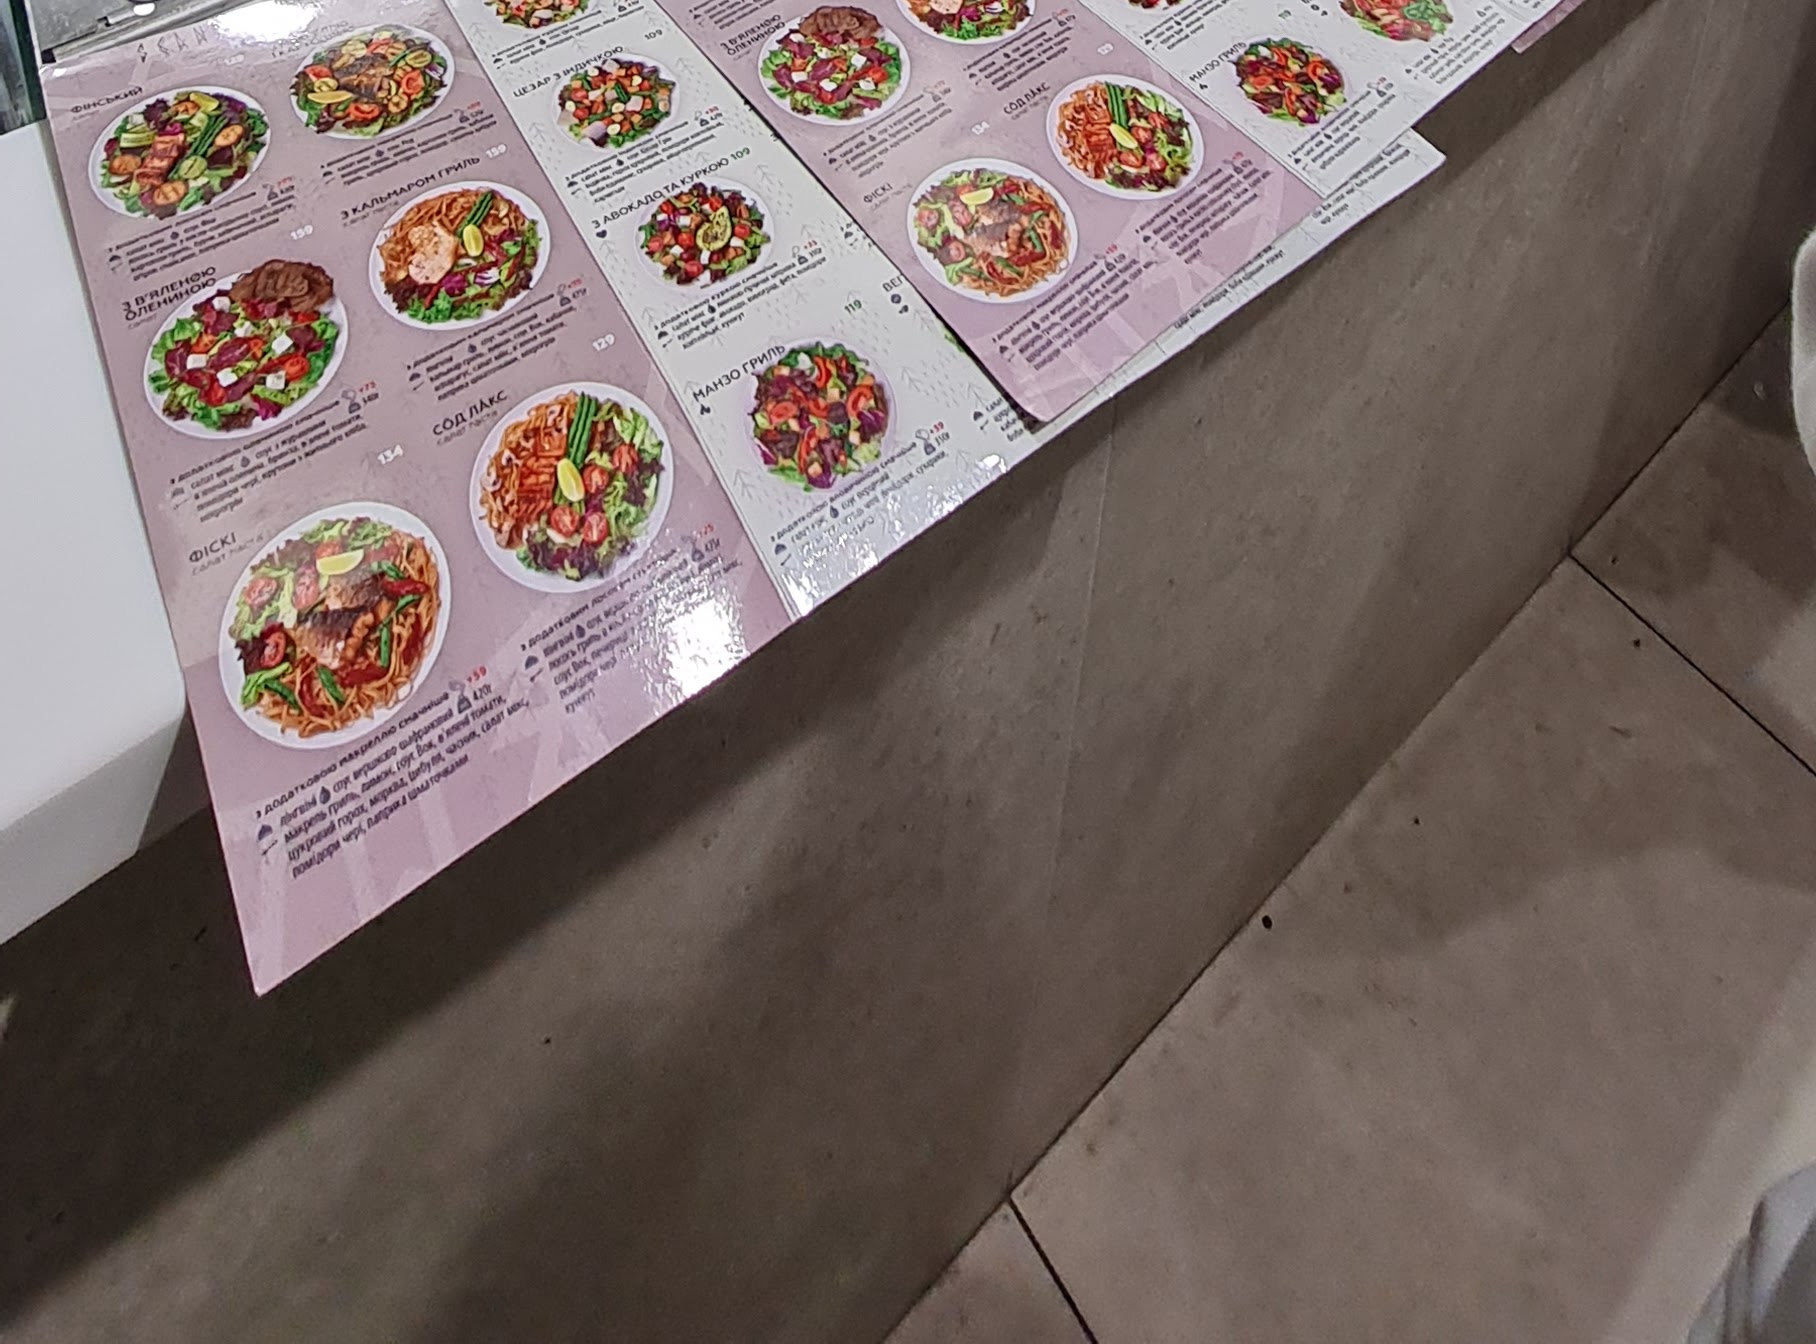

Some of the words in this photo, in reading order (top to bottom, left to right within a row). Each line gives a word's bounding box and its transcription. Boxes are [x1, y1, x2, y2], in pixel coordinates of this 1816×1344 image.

[513, 75, 551, 98] ЦЕЗАР
[563, 45, 624, 78] ІНДИЧКОЮ
[681, 158, 729, 187] КУРКОЮ
[730, 147, 751, 162] 109
[351, 173, 436, 214] КАЛЬМАРОМ
[438, 157, 480, 179] ГРИЛЬ
[863, 183, 893, 204] ФІСКІ
[844, 299, 863, 314] 119
[592, 334, 615, 351] 129
[693, 368, 741, 403] МАНЗО
[742, 345, 786, 375] ГРИЛЬ
[377, 444, 404, 465] 134
[189, 532, 236, 563] ФІСКІ
